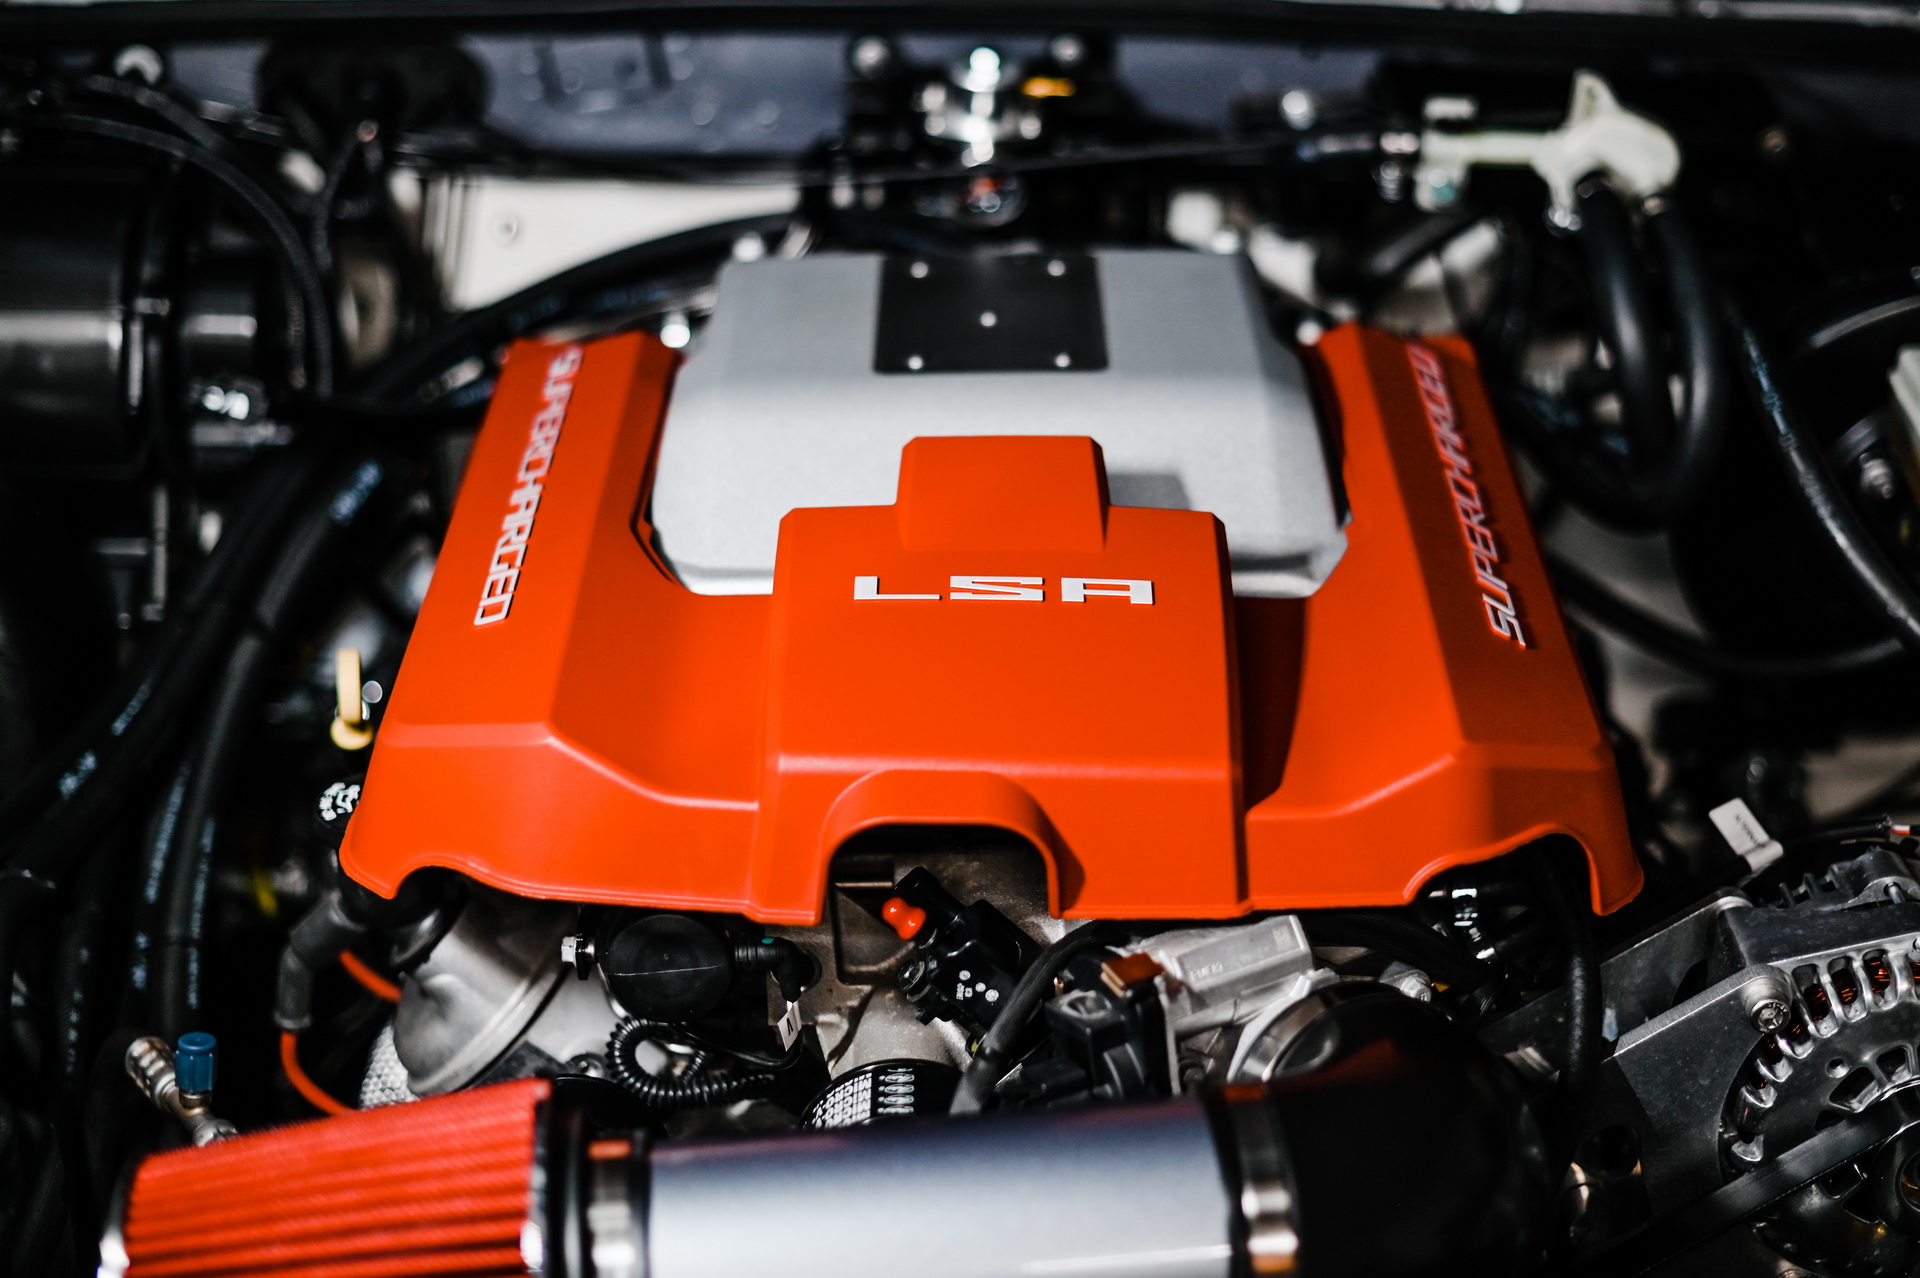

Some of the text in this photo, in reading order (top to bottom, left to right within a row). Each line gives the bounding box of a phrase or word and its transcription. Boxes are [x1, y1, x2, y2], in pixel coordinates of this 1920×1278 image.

[474, 346, 582, 627] SUPERCHARGED
[853, 575, 1153, 605] LSA
[1406, 343, 1526, 648] SUPERCHARGED
